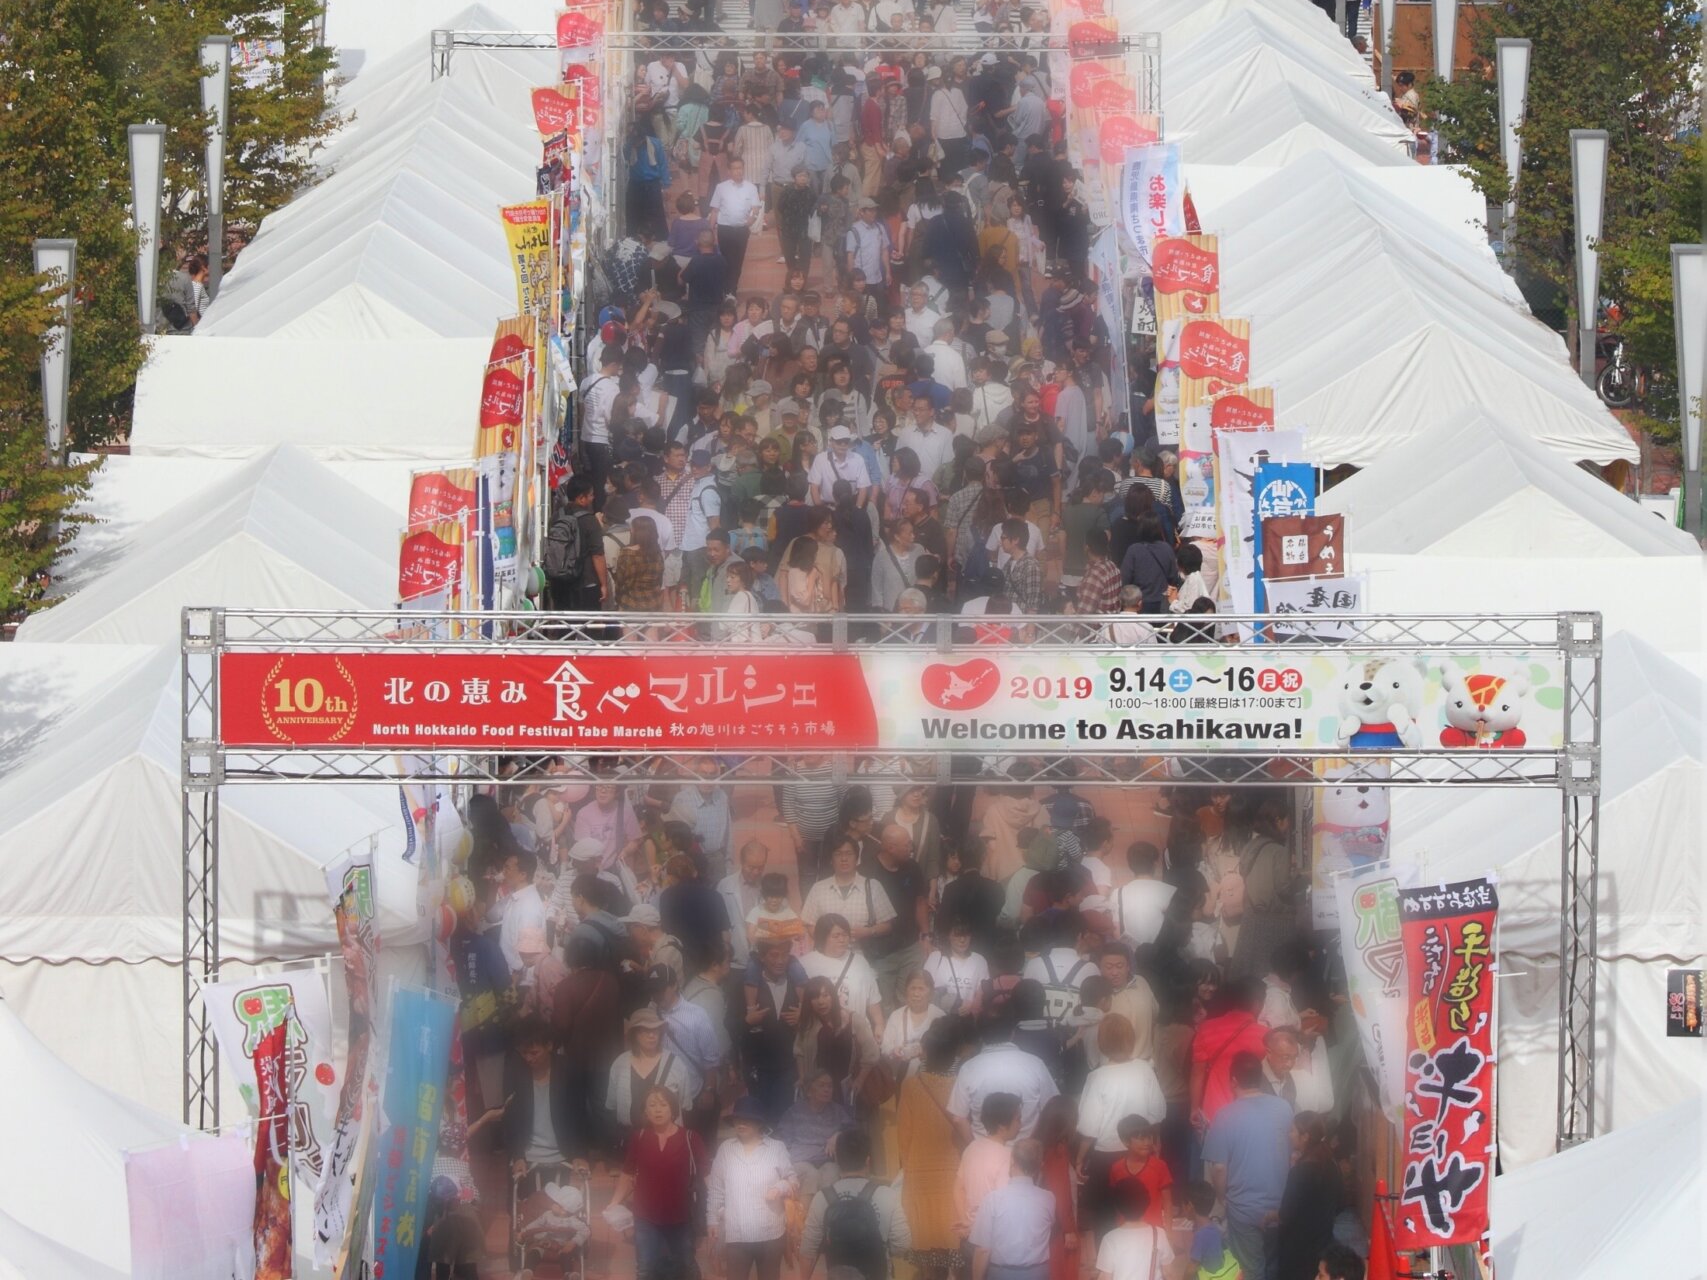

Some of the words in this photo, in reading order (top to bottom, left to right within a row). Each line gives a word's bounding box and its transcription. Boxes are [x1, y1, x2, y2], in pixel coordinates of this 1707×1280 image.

[274, 677, 349, 713] 10th
[383, 676, 528, 706] 北の恵み
[543, 660, 817, 721] 食べマルシェ
[1009, 676, 1093, 700] 2019
[276, 717, 344, 725] ANNIVERSARY
[372, 724, 411, 736] North
[415, 724, 478, 736] Hokkaido
[482, 724, 515, 737] Food
[518, 725, 573, 737] Festival
[578, 726, 609, 737] Tabe
[613, 725, 663, 738] Marché
[669, 722, 836, 737] 秋の旭川はごちそう市場
[921, 719, 1066, 740] Welcome
[1077, 719, 1106, 740] to
[1115, 718, 1302, 740] Asahikawa!
